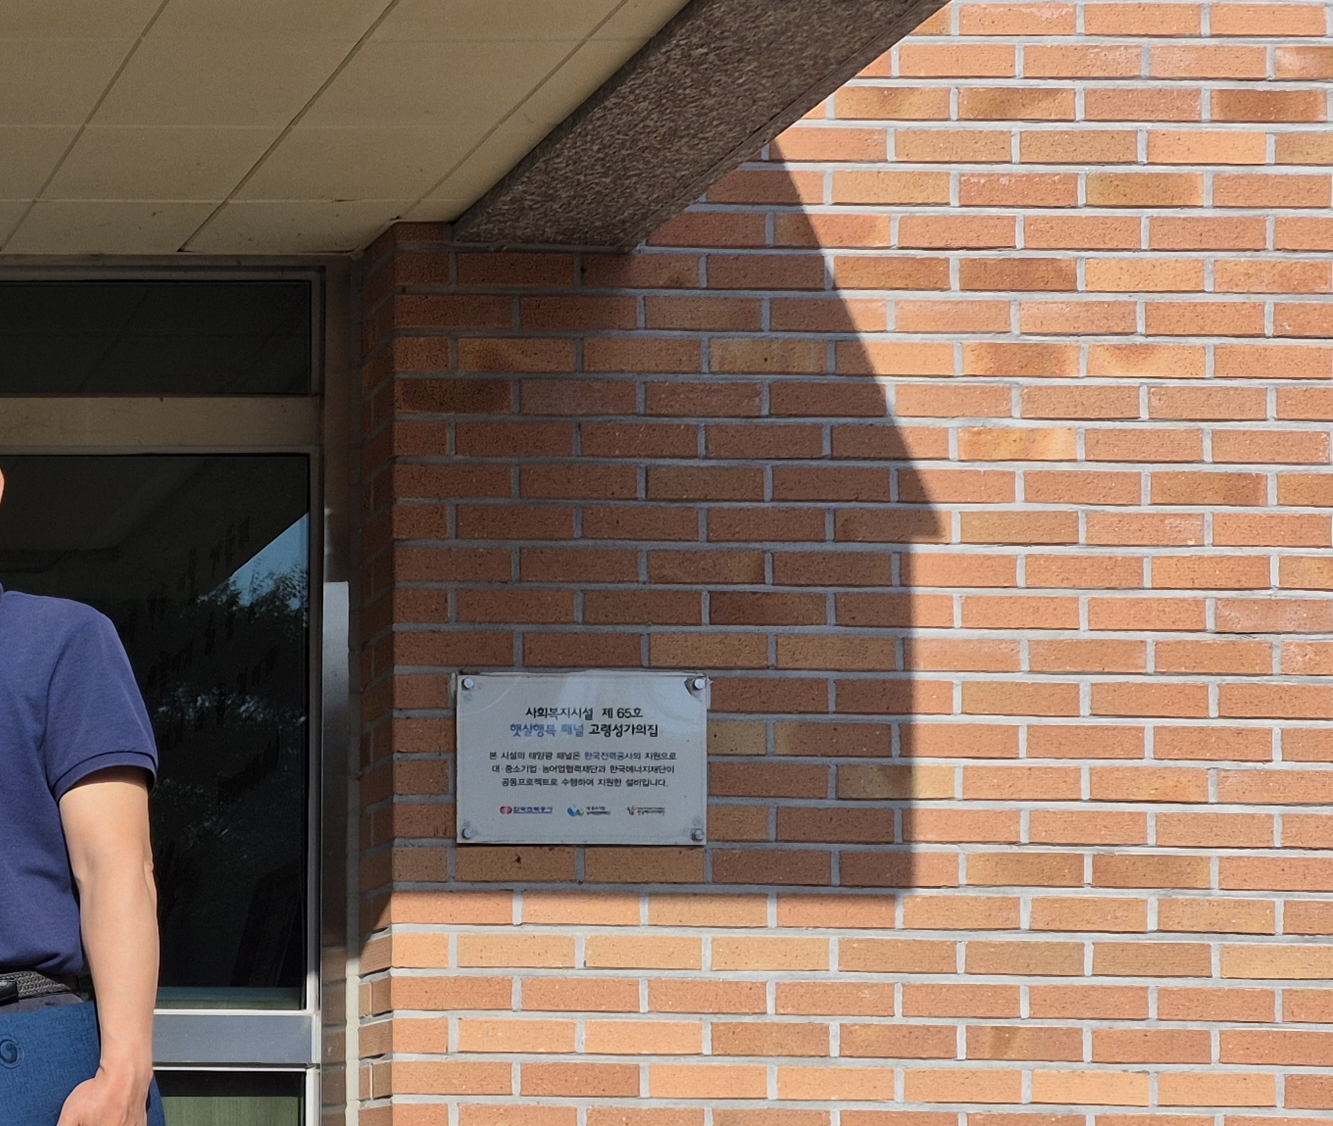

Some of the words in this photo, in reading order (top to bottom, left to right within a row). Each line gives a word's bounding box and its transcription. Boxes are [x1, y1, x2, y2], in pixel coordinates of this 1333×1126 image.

[525, 707, 594, 720] 사회복지시설
[602, 707, 614, 719] 제
[617, 707, 643, 719] 65호
[561, 724, 584, 736] 패널
[588, 723, 659, 737] 고령성가의집
[489, 751, 497, 761] 본
[501, 751, 525, 761] 시설의
[529, 751, 553, 761] 태양광
[584, 751, 641, 761] 한국전력공사의
[645, 751, 677, 761] 지원으로
[610, 764, 675, 774] 한국에너지재단이
[501, 777, 558, 787] 공동프로젝트로
[561, 777, 594, 787] 수행하여
[597, 777, 622, 787] 지원한
